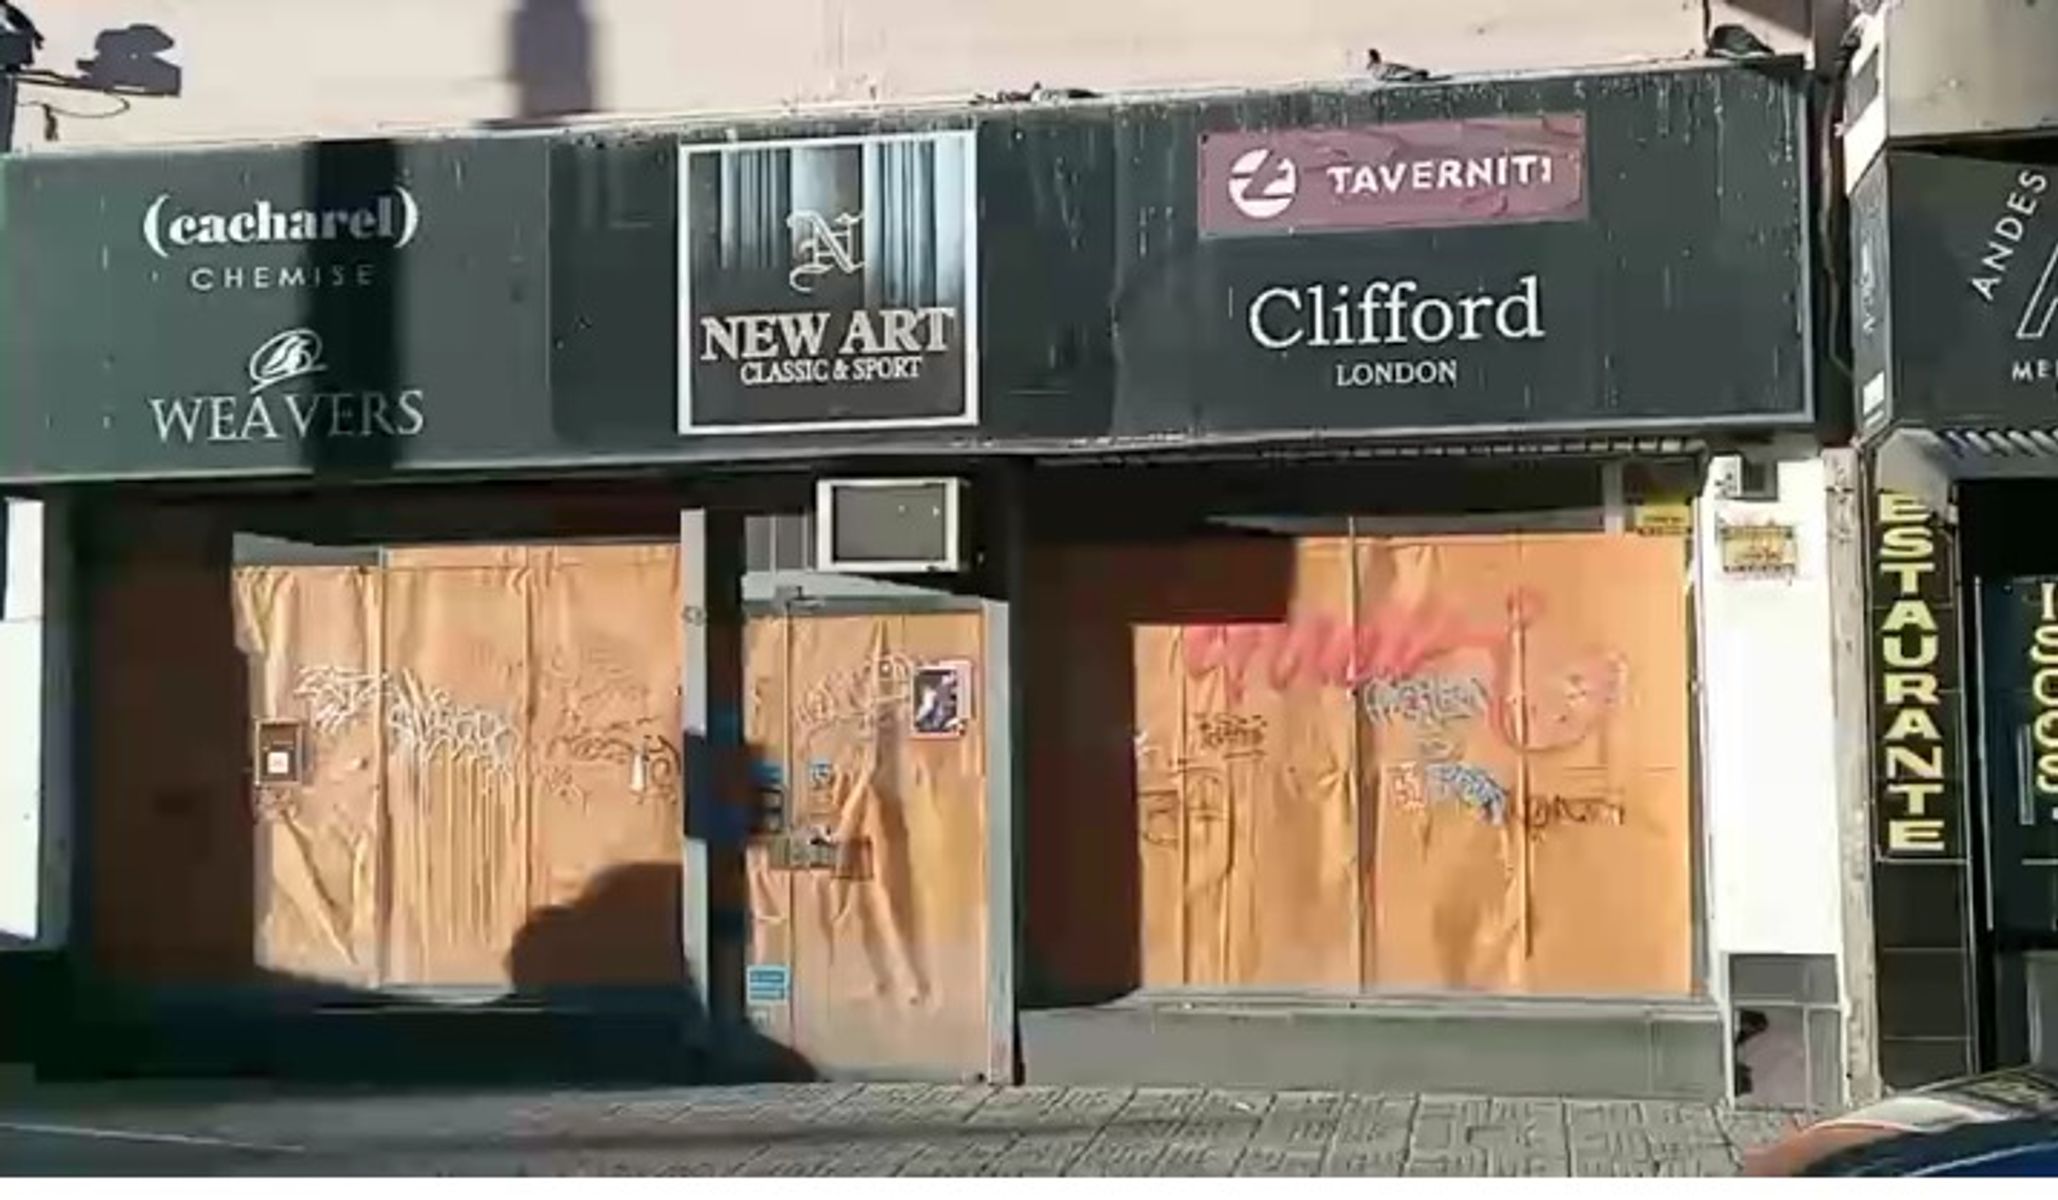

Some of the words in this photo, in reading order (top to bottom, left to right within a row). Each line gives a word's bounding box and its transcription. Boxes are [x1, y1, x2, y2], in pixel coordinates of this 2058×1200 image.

[1327, 153, 1553, 195] TAVERNITI
[1971, 169, 2047, 300] ANDES
[190, 264, 375, 291] CHEMISE
[1248, 275, 1545, 349] Clifford
[700, 313, 831, 360] NEW
[838, 307, 955, 354] ART
[740, 359, 828, 385] CLASSIC
[832, 357, 849, 380] &
[852, 355, 923, 380] SPORT
[1336, 358, 1457, 387] LONDON
[2011, 358, 2058, 381] ME
[151, 389, 425, 442] WEAVERS
